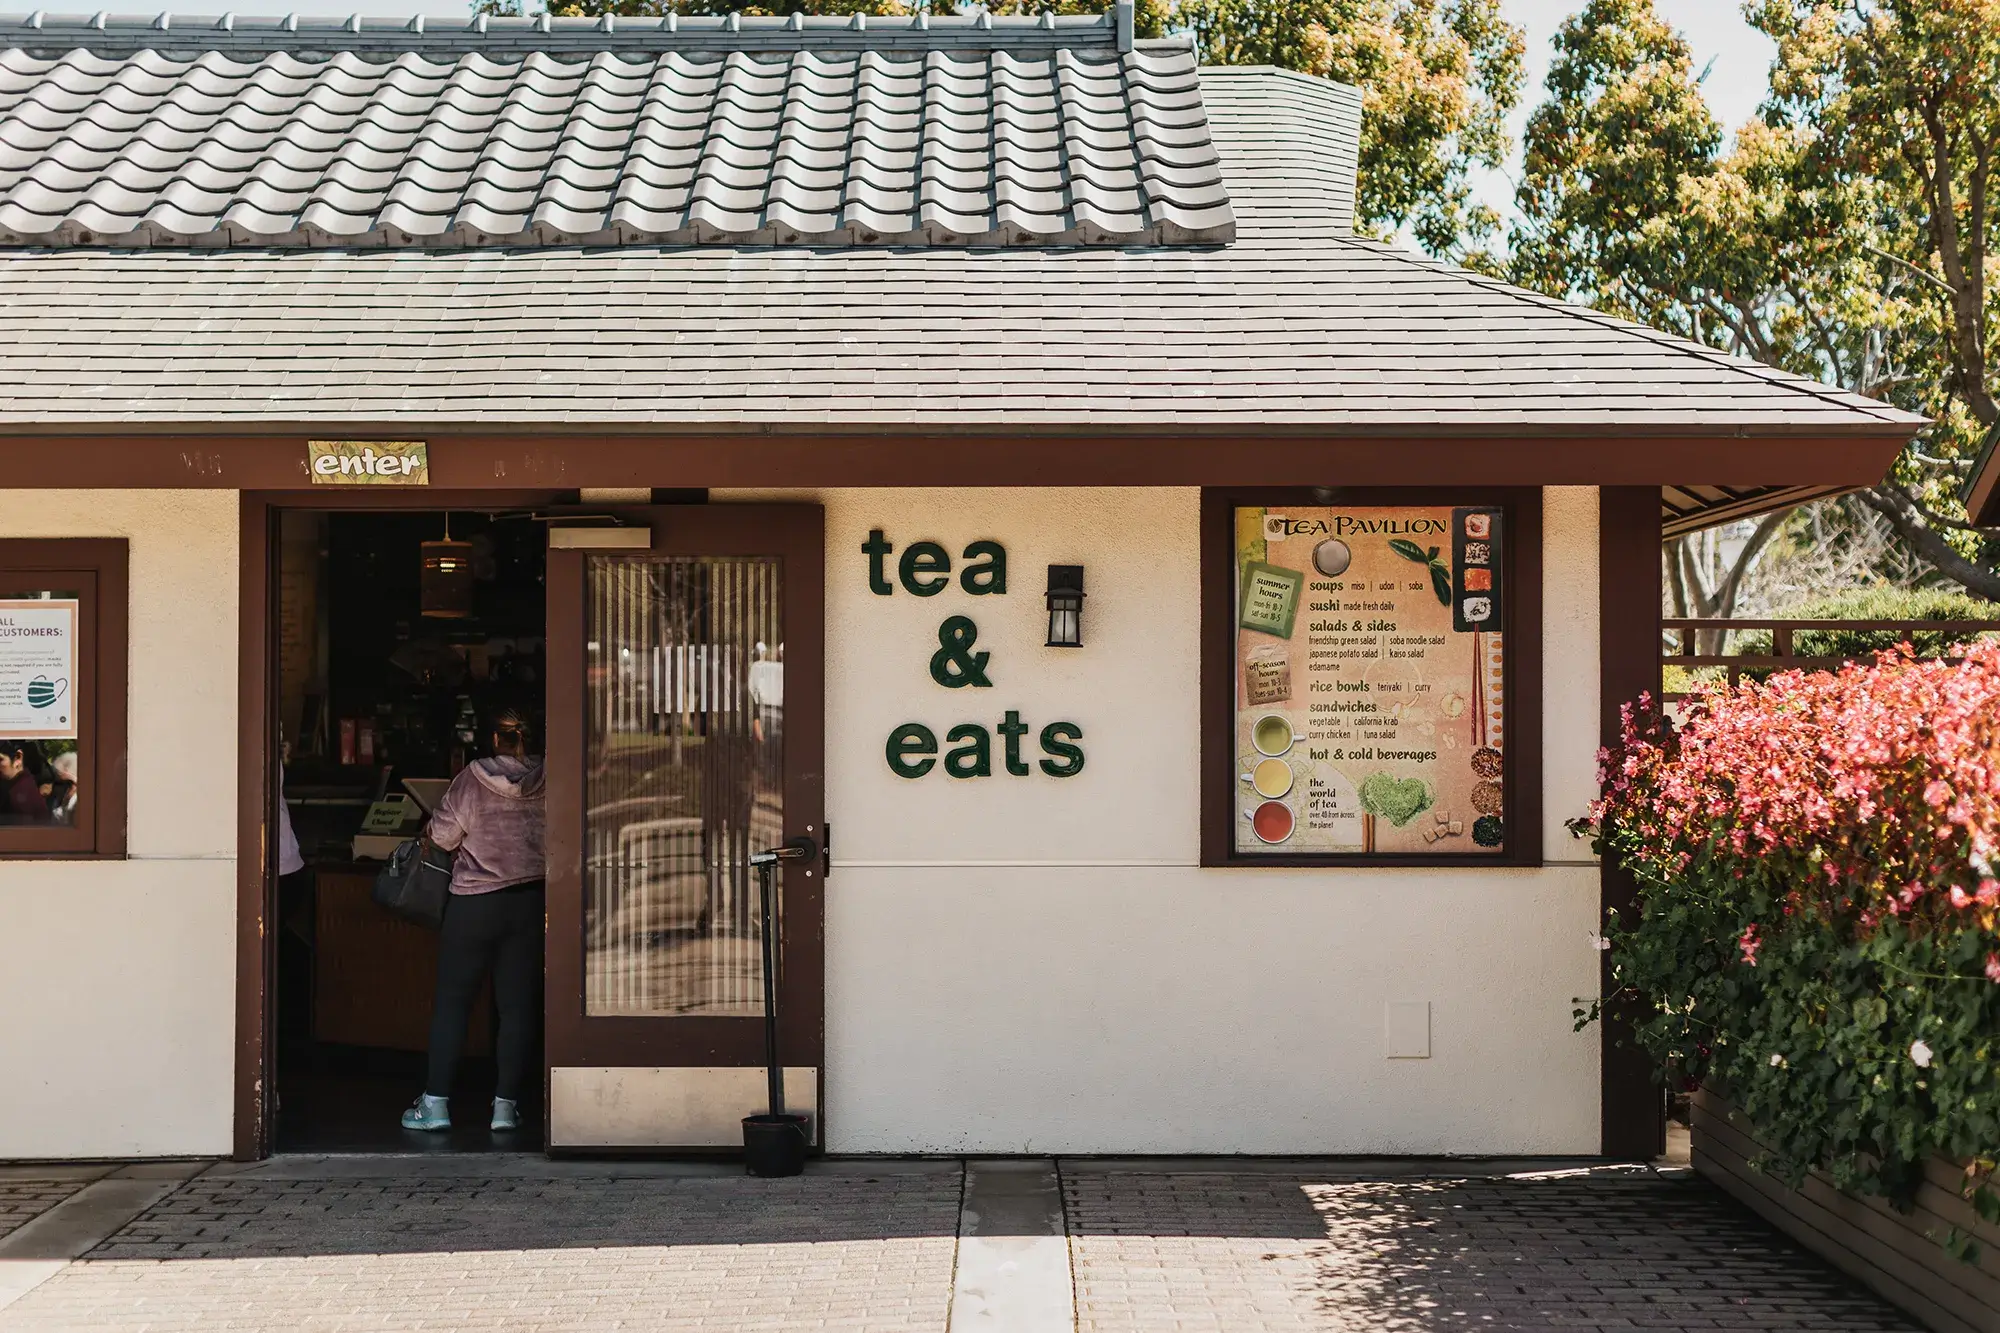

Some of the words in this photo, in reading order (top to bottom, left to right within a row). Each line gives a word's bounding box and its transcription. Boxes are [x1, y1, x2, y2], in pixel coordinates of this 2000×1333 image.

[314, 447, 421, 475] enter
[1280, 517, 1329, 536] TEA
[1334, 516, 1447, 536] PAVILION
[861, 530, 1006, 597] tea
[1256, 577, 1290, 590] summer
[1309, 581, 1344, 594] soups
[1351, 581, 1365, 591] miso
[1379, 581, 1395, 591] udon
[1408, 581, 1424, 591] soba
[1258, 586, 1283, 600] hours
[1309, 599, 1340, 612] sushi
[1343, 601, 1361, 611] made
[1362, 601, 1378, 611] fresh
[1380, 601, 1395, 612] daily
[1309, 620, 1348, 632] salads
[1352, 620, 1363, 632] &
[1367, 620, 1397, 632] sides
[1308, 635, 1339, 646] friendship
[1340, 637, 1359, 647] green
[1360, 635, 1377, 645] salad
[1389, 635, 1405, 645] soba
[1406, 635, 1428, 645] noodle
[1428, 635, 1446, 645] salad
[930, 615, 994, 688] &
[1309, 649, 1338, 660] japanese
[1339, 649, 1361, 660] potato
[1361, 649, 1379, 659] salad
[1389, 649, 1406, 659] kaiso
[1407, 649, 1425, 659] salad
[1249, 660, 1286, 671] off-season
[1308, 662, 1340, 671] edamame
[1258, 670, 1279, 678] hours
[1309, 680, 1333, 692] rice
[1336, 680, 1370, 692] bowls
[1377, 682, 1402, 692] teriyaki
[1414, 683, 1431, 692] curry
[1309, 700, 1377, 713] sandwiches
[1309, 716, 1341, 727] vegetable
[1354, 716, 1383, 726] california
[1383, 716, 1399, 726] krab
[1309, 732, 1325, 741] curry
[1326, 730, 1351, 739] chicken
[1364, 731, 1378, 739] tuna
[1379, 730, 1396, 739] salad
[886, 711, 1085, 778] eats
[1309, 748, 1329, 760] hot
[1333, 748, 1344, 760] &
[1348, 748, 1373, 760] cold
[1377, 748, 1437, 763] beverages
[1309, 778, 1324, 788] the
[1309, 788, 1336, 798] world
[1309, 799, 1320, 810] of
[1321, 799, 1337, 808] tea
[1318, 821, 1334, 829] planet
